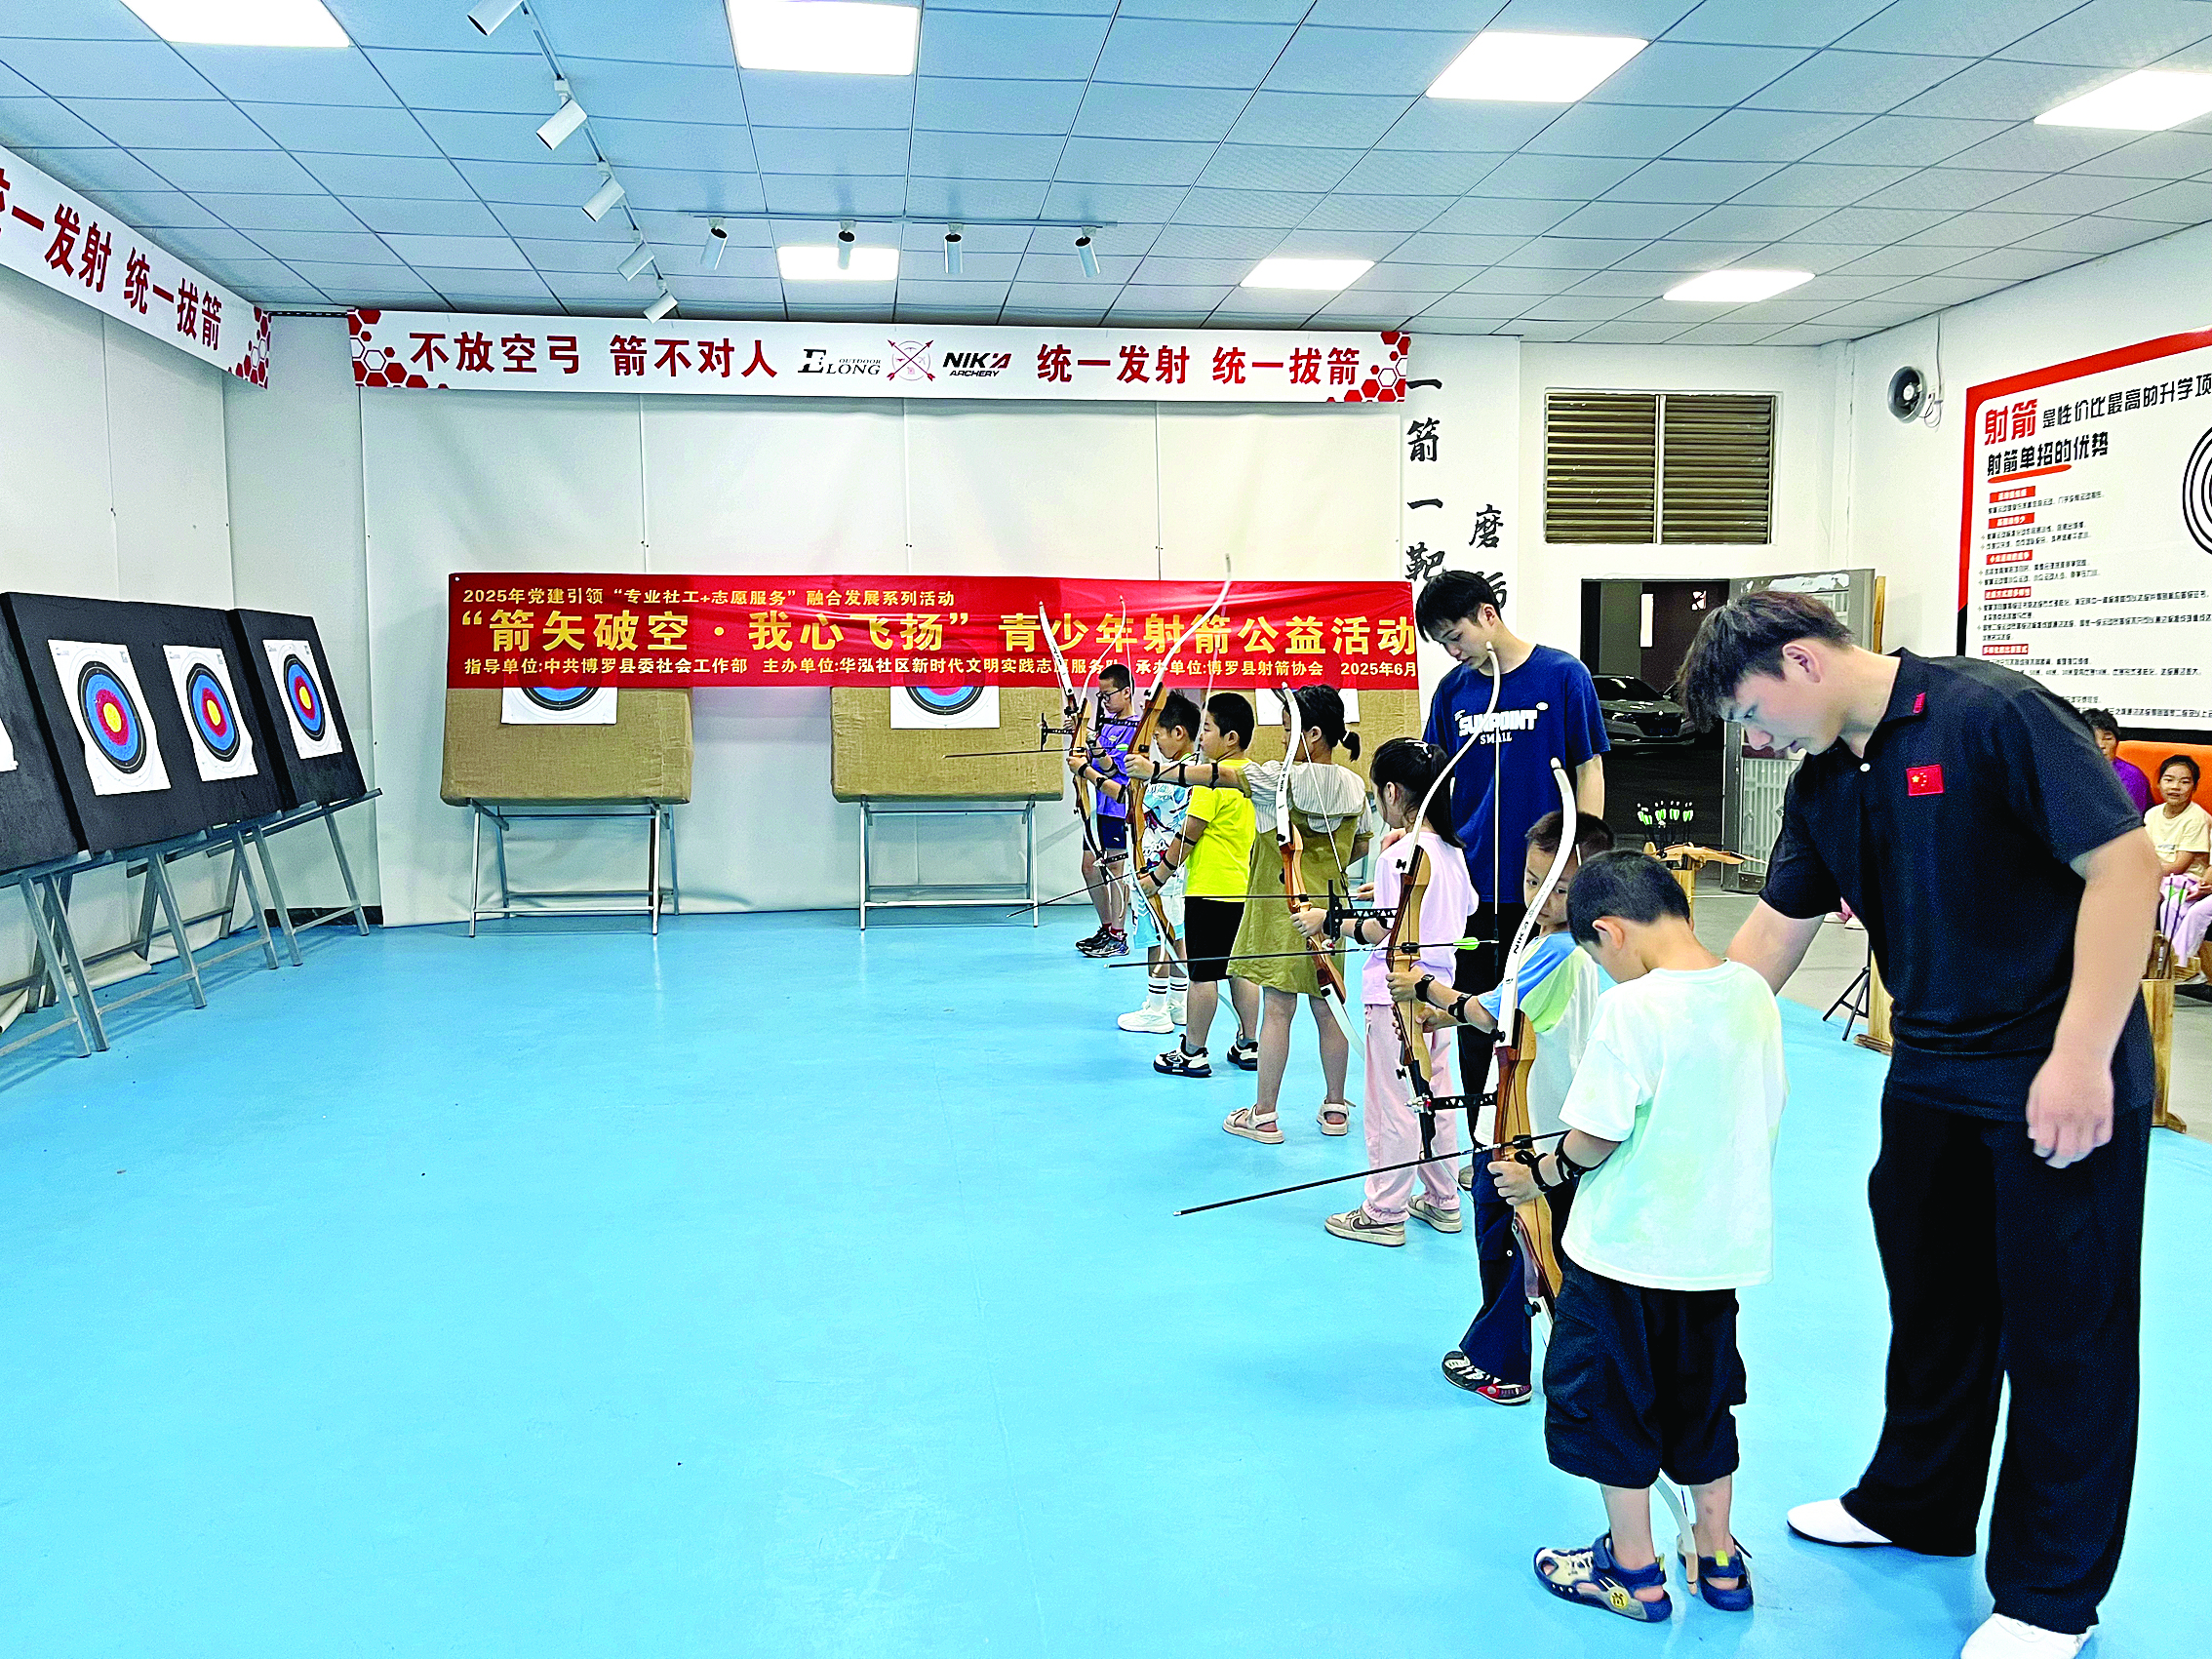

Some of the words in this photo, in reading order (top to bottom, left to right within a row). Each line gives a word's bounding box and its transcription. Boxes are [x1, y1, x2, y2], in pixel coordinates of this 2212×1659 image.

[0, 167, 112, 292] 一发射
[124, 247, 222, 350] 统一拔箭
[410, 331, 580, 375] 不放空弓
[610, 334, 778, 377] 箭不对人
[1037, 343, 1190, 384] 统一发射
[1212, 346, 1360, 386] 统一拔箭
[1985, 399, 2038, 446] 射箭
[1988, 431, 2109, 476] 射箭单招的优势
[1340, 661, 1417, 677] 2025年6月
